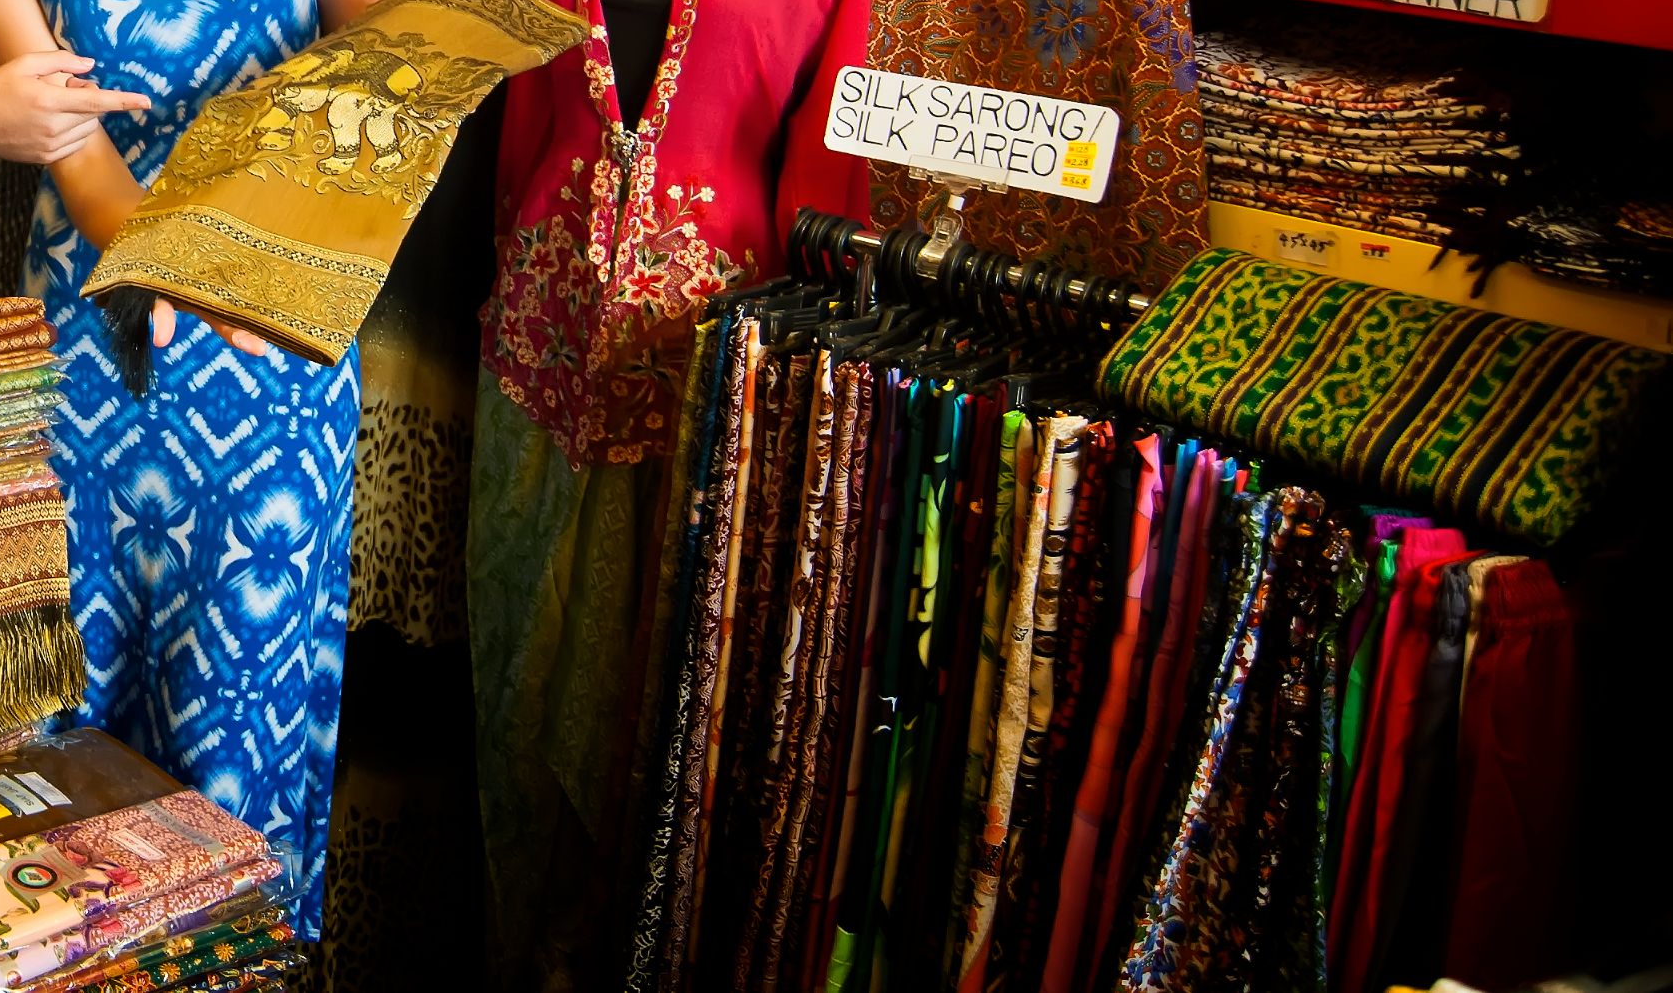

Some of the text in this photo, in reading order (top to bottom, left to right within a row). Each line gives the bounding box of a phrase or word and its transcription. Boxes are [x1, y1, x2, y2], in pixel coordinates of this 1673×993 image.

[840, 70, 924, 114] SILK
[832, 106, 1058, 177] SILK PAREO
